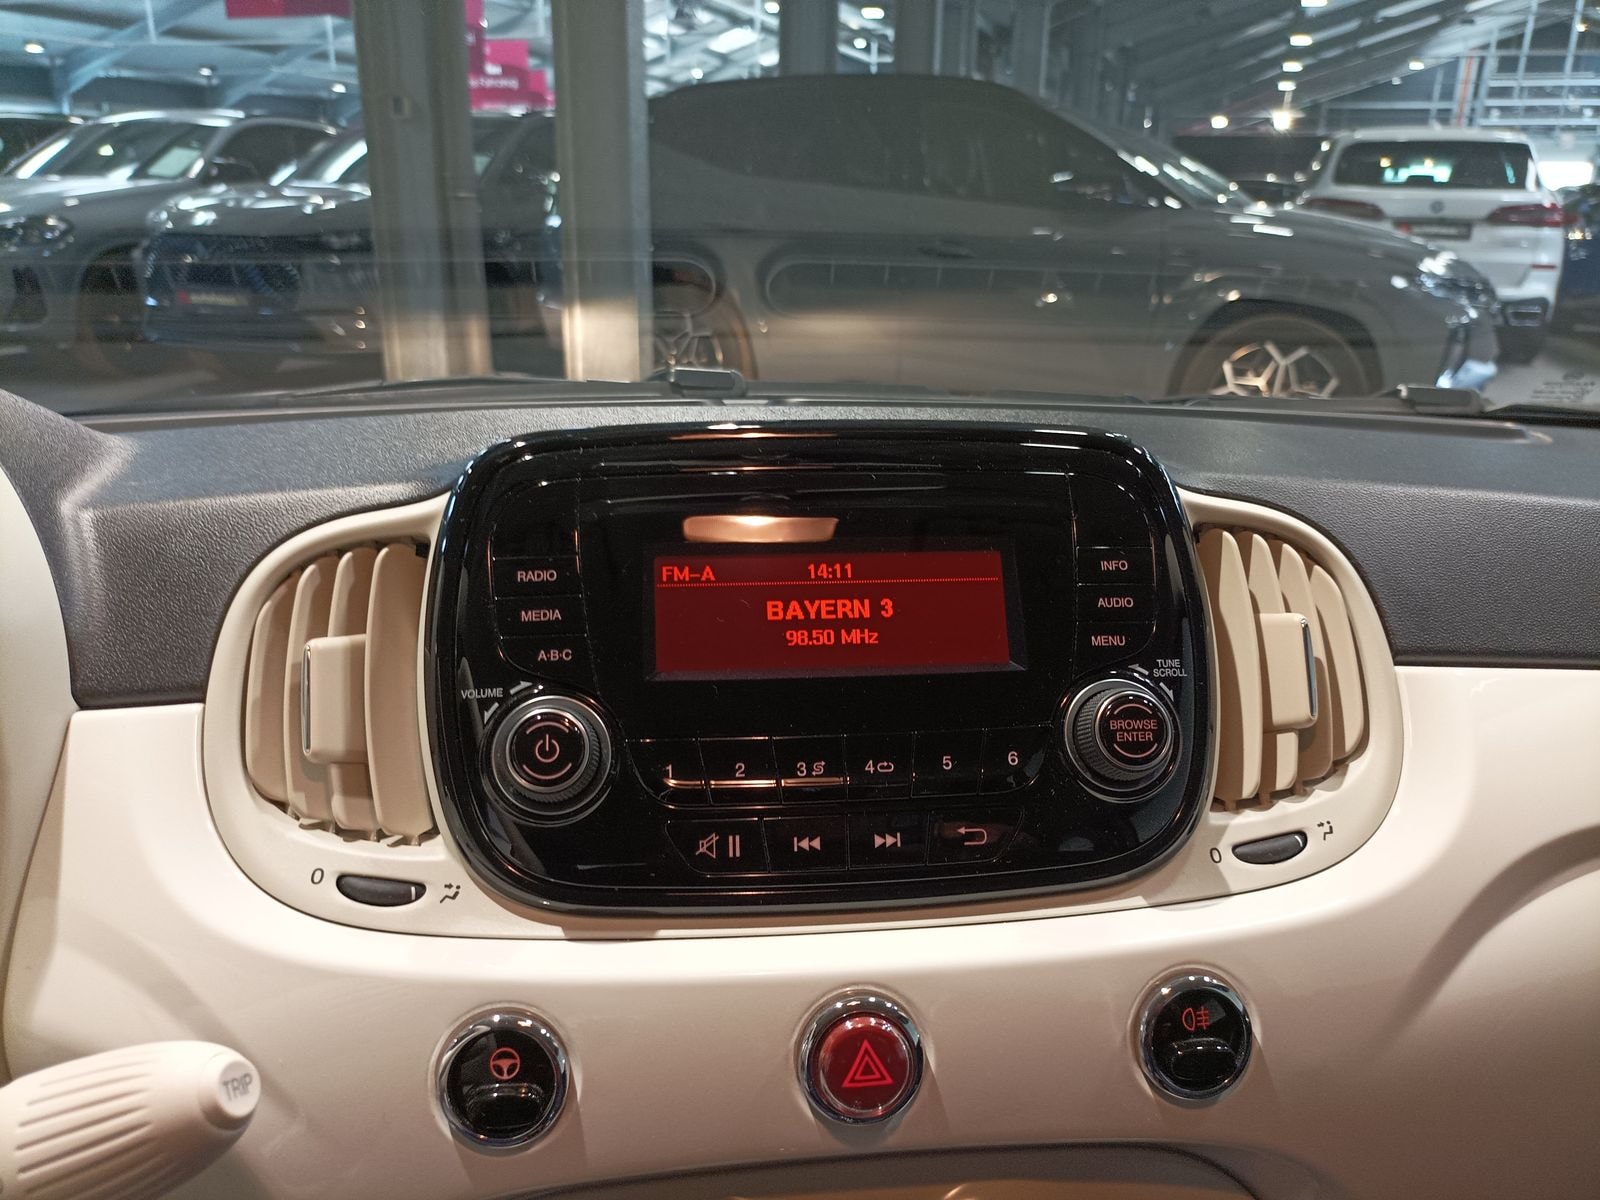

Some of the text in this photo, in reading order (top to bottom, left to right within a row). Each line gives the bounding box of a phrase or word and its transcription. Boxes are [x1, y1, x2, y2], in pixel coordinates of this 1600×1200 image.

[807, 563, 853, 579] 14:11
[1100, 560, 1128, 571] INFO
[517, 570, 557, 582] RADIO
[662, 566, 716, 582] FM-A
[766, 598, 894, 621] BAYERN 3
[1097, 597, 1134, 608] AUDIO
[521, 609, 562, 622] MEDIA
[785, 629, 879, 646] 98.50 MHz
[1091, 635, 1126, 646] MENU
[1156, 659, 1181, 668] TUNE
[1153, 668, 1187, 677] SCROLL
[461, 688, 504, 699] VOLUME
[1109, 719, 1158, 730] BROWSE
[1116, 731, 1153, 742] ENTER
[942, 756, 952, 770] 5
[1007, 751, 1019, 766] 6
[665, 763, 673, 778] 1
[735, 762, 746, 777] 2
[796, 761, 807, 777] 3
[864, 760, 875, 774] 4
[222, 1072, 253, 1102] TRIP
